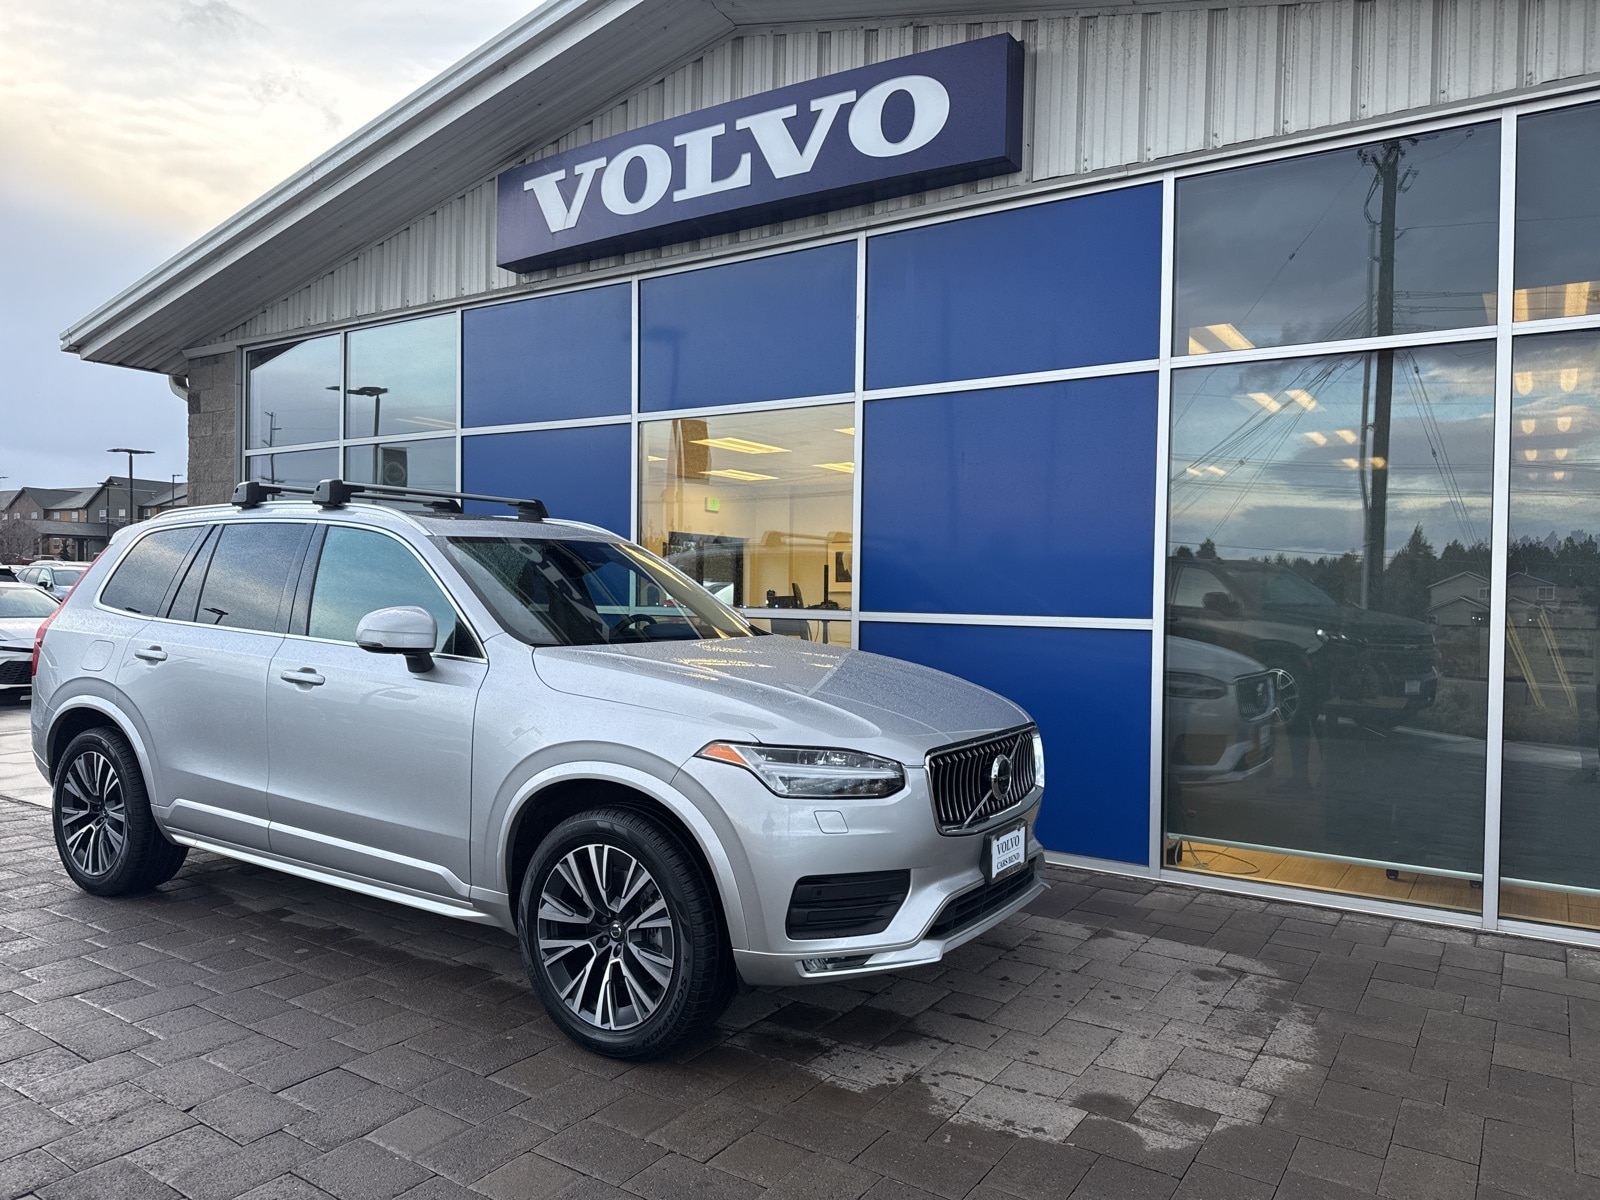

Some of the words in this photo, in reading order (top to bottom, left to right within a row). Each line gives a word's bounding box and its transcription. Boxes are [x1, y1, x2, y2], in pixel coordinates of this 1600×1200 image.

[523, 74, 950, 233] VOLVO
[997, 834, 1020, 855] VOLVO
[997, 857, 1008, 870] CARS
[1007, 852, 1020, 865] BEND
[643, 976, 688, 1046] SCORPION
